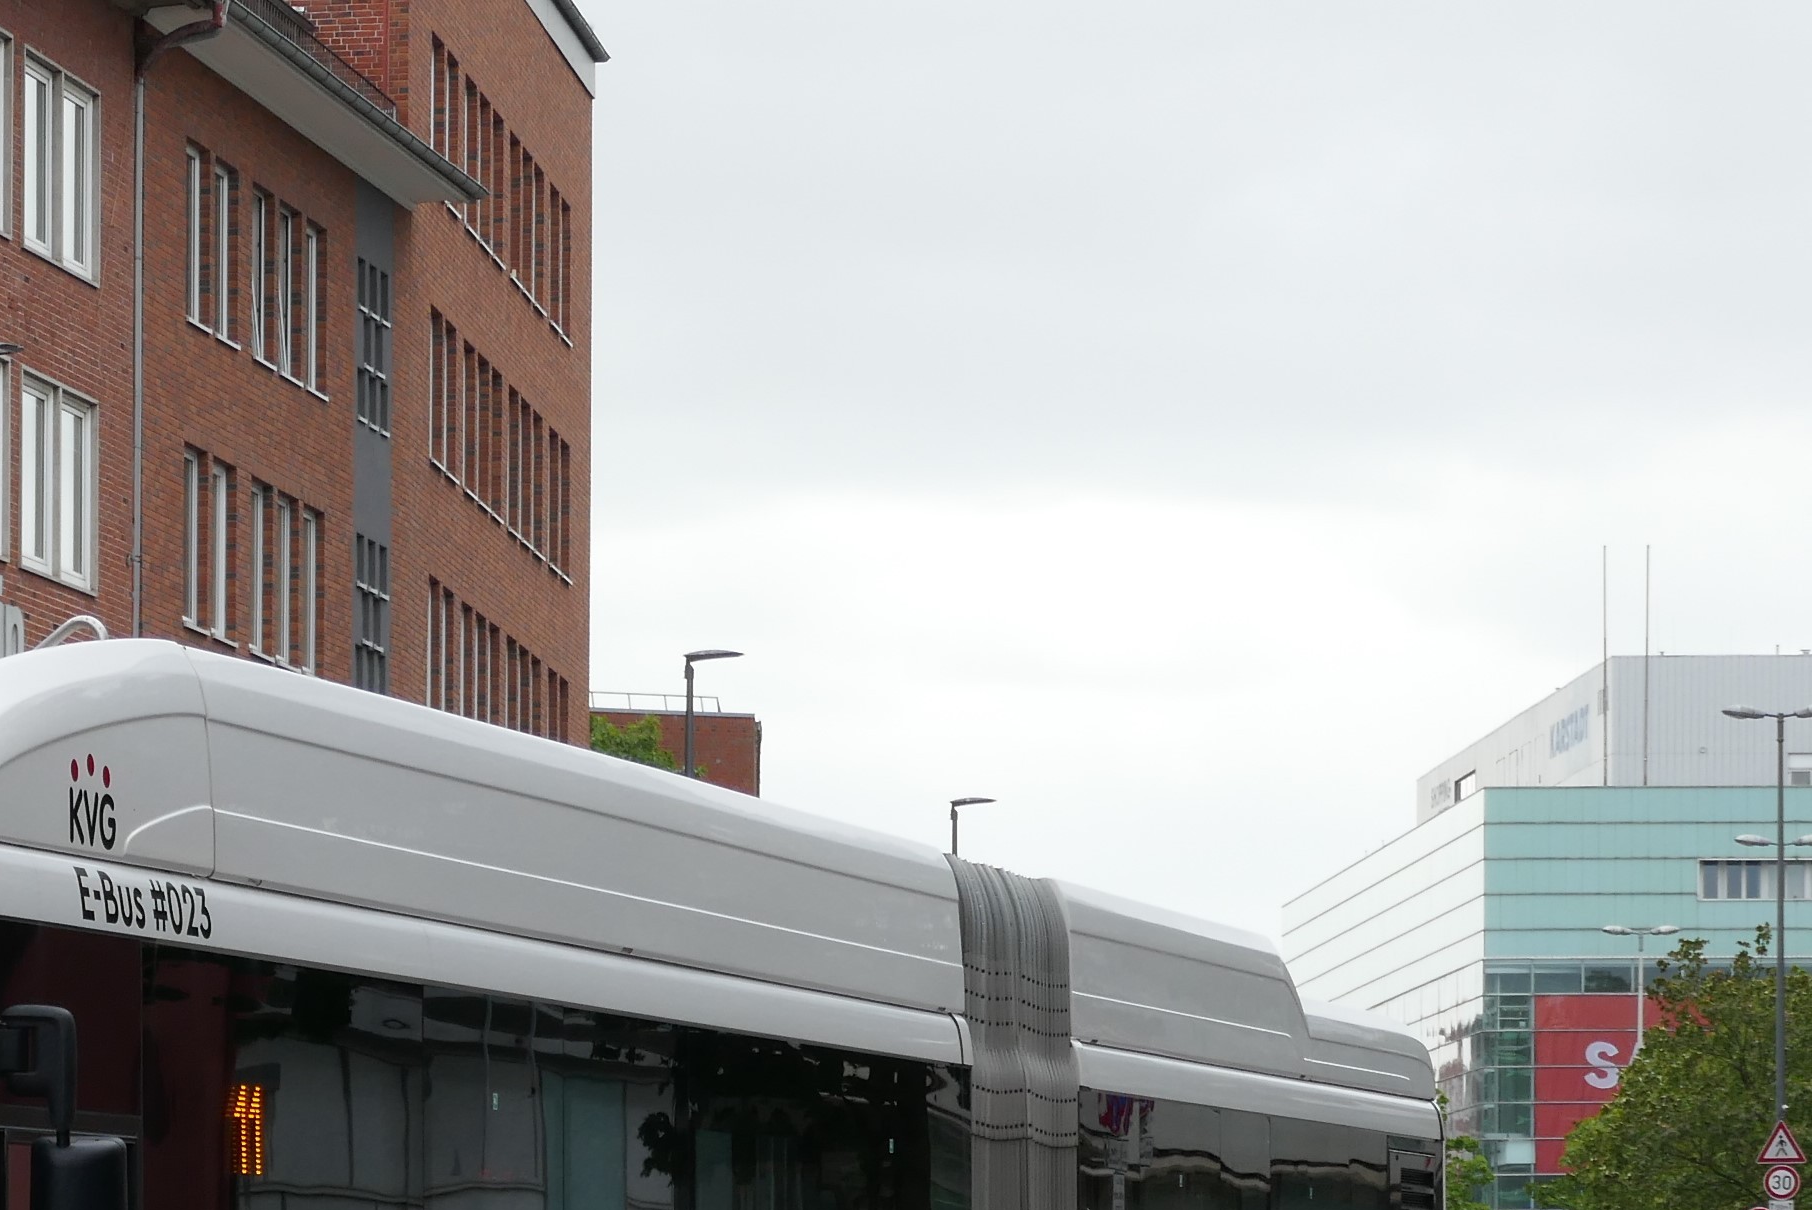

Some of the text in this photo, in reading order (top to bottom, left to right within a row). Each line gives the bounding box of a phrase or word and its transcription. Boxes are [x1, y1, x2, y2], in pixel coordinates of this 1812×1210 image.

[69, 786, 117, 850] KVG
[73, 866, 212, 940] E-Bus #023
[1771, 1175, 1793, 1191] 30
